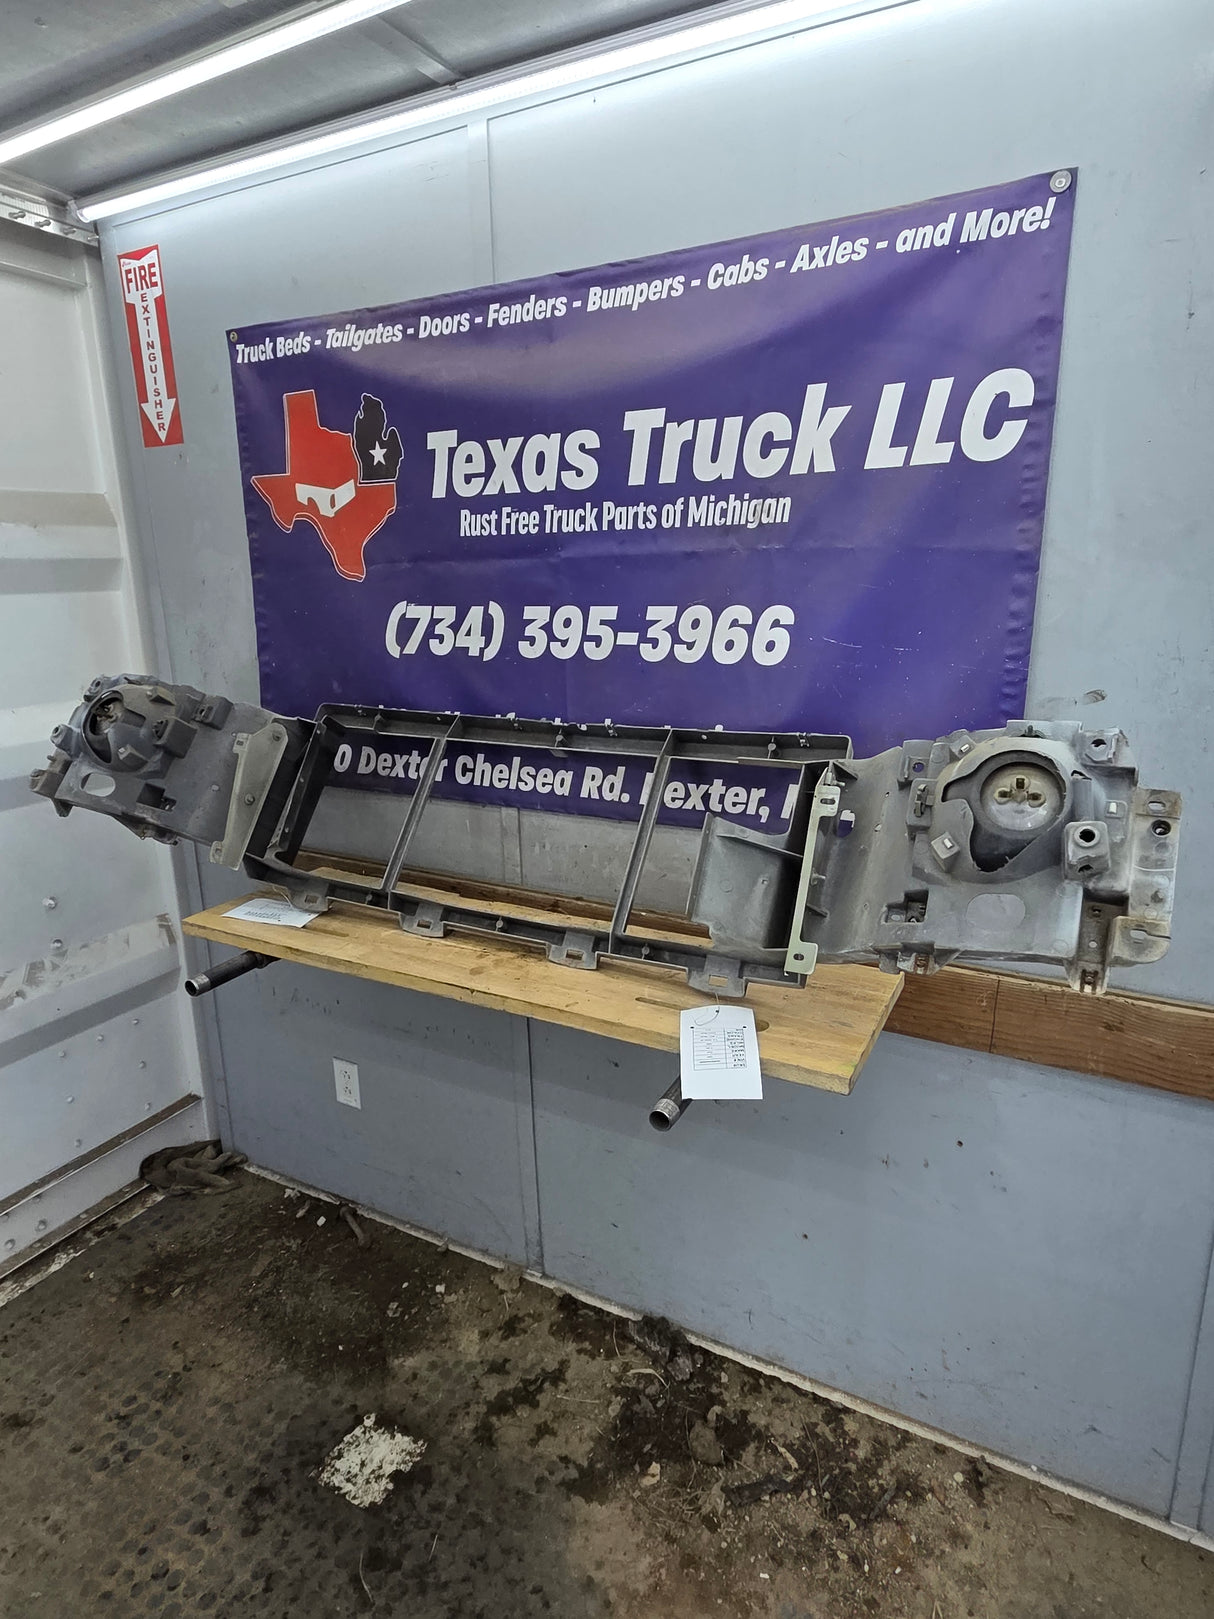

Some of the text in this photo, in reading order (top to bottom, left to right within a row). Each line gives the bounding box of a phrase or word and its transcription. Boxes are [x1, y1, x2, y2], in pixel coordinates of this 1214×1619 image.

[124, 262, 158, 294] FIRE
[236, 337, 274, 364] Truck
[276, 330, 311, 356] Beds
[325, 324, 402, 352] Tailgates
[419, 312, 470, 339] Doors
[487, 294, 567, 328] Fenders
[587, 276, 684, 312] Bumpers
[707, 254, 768, 290] Cabs
[790, 236, 868, 273] Axles
[895, 213, 956, 254] and
[960, 197, 1056, 243] More!
[140, 292, 166, 432] EXTINGUISHER
[426, 367, 1035, 499] Texas Truck LLC
[459, 494, 791, 538] Rust Free Truck Parts of Michigan
[385, 600, 796, 666] (734) 395-3966
[455, 753, 573, 799] Chelsea
[580, 766, 630, 803] Rd.
